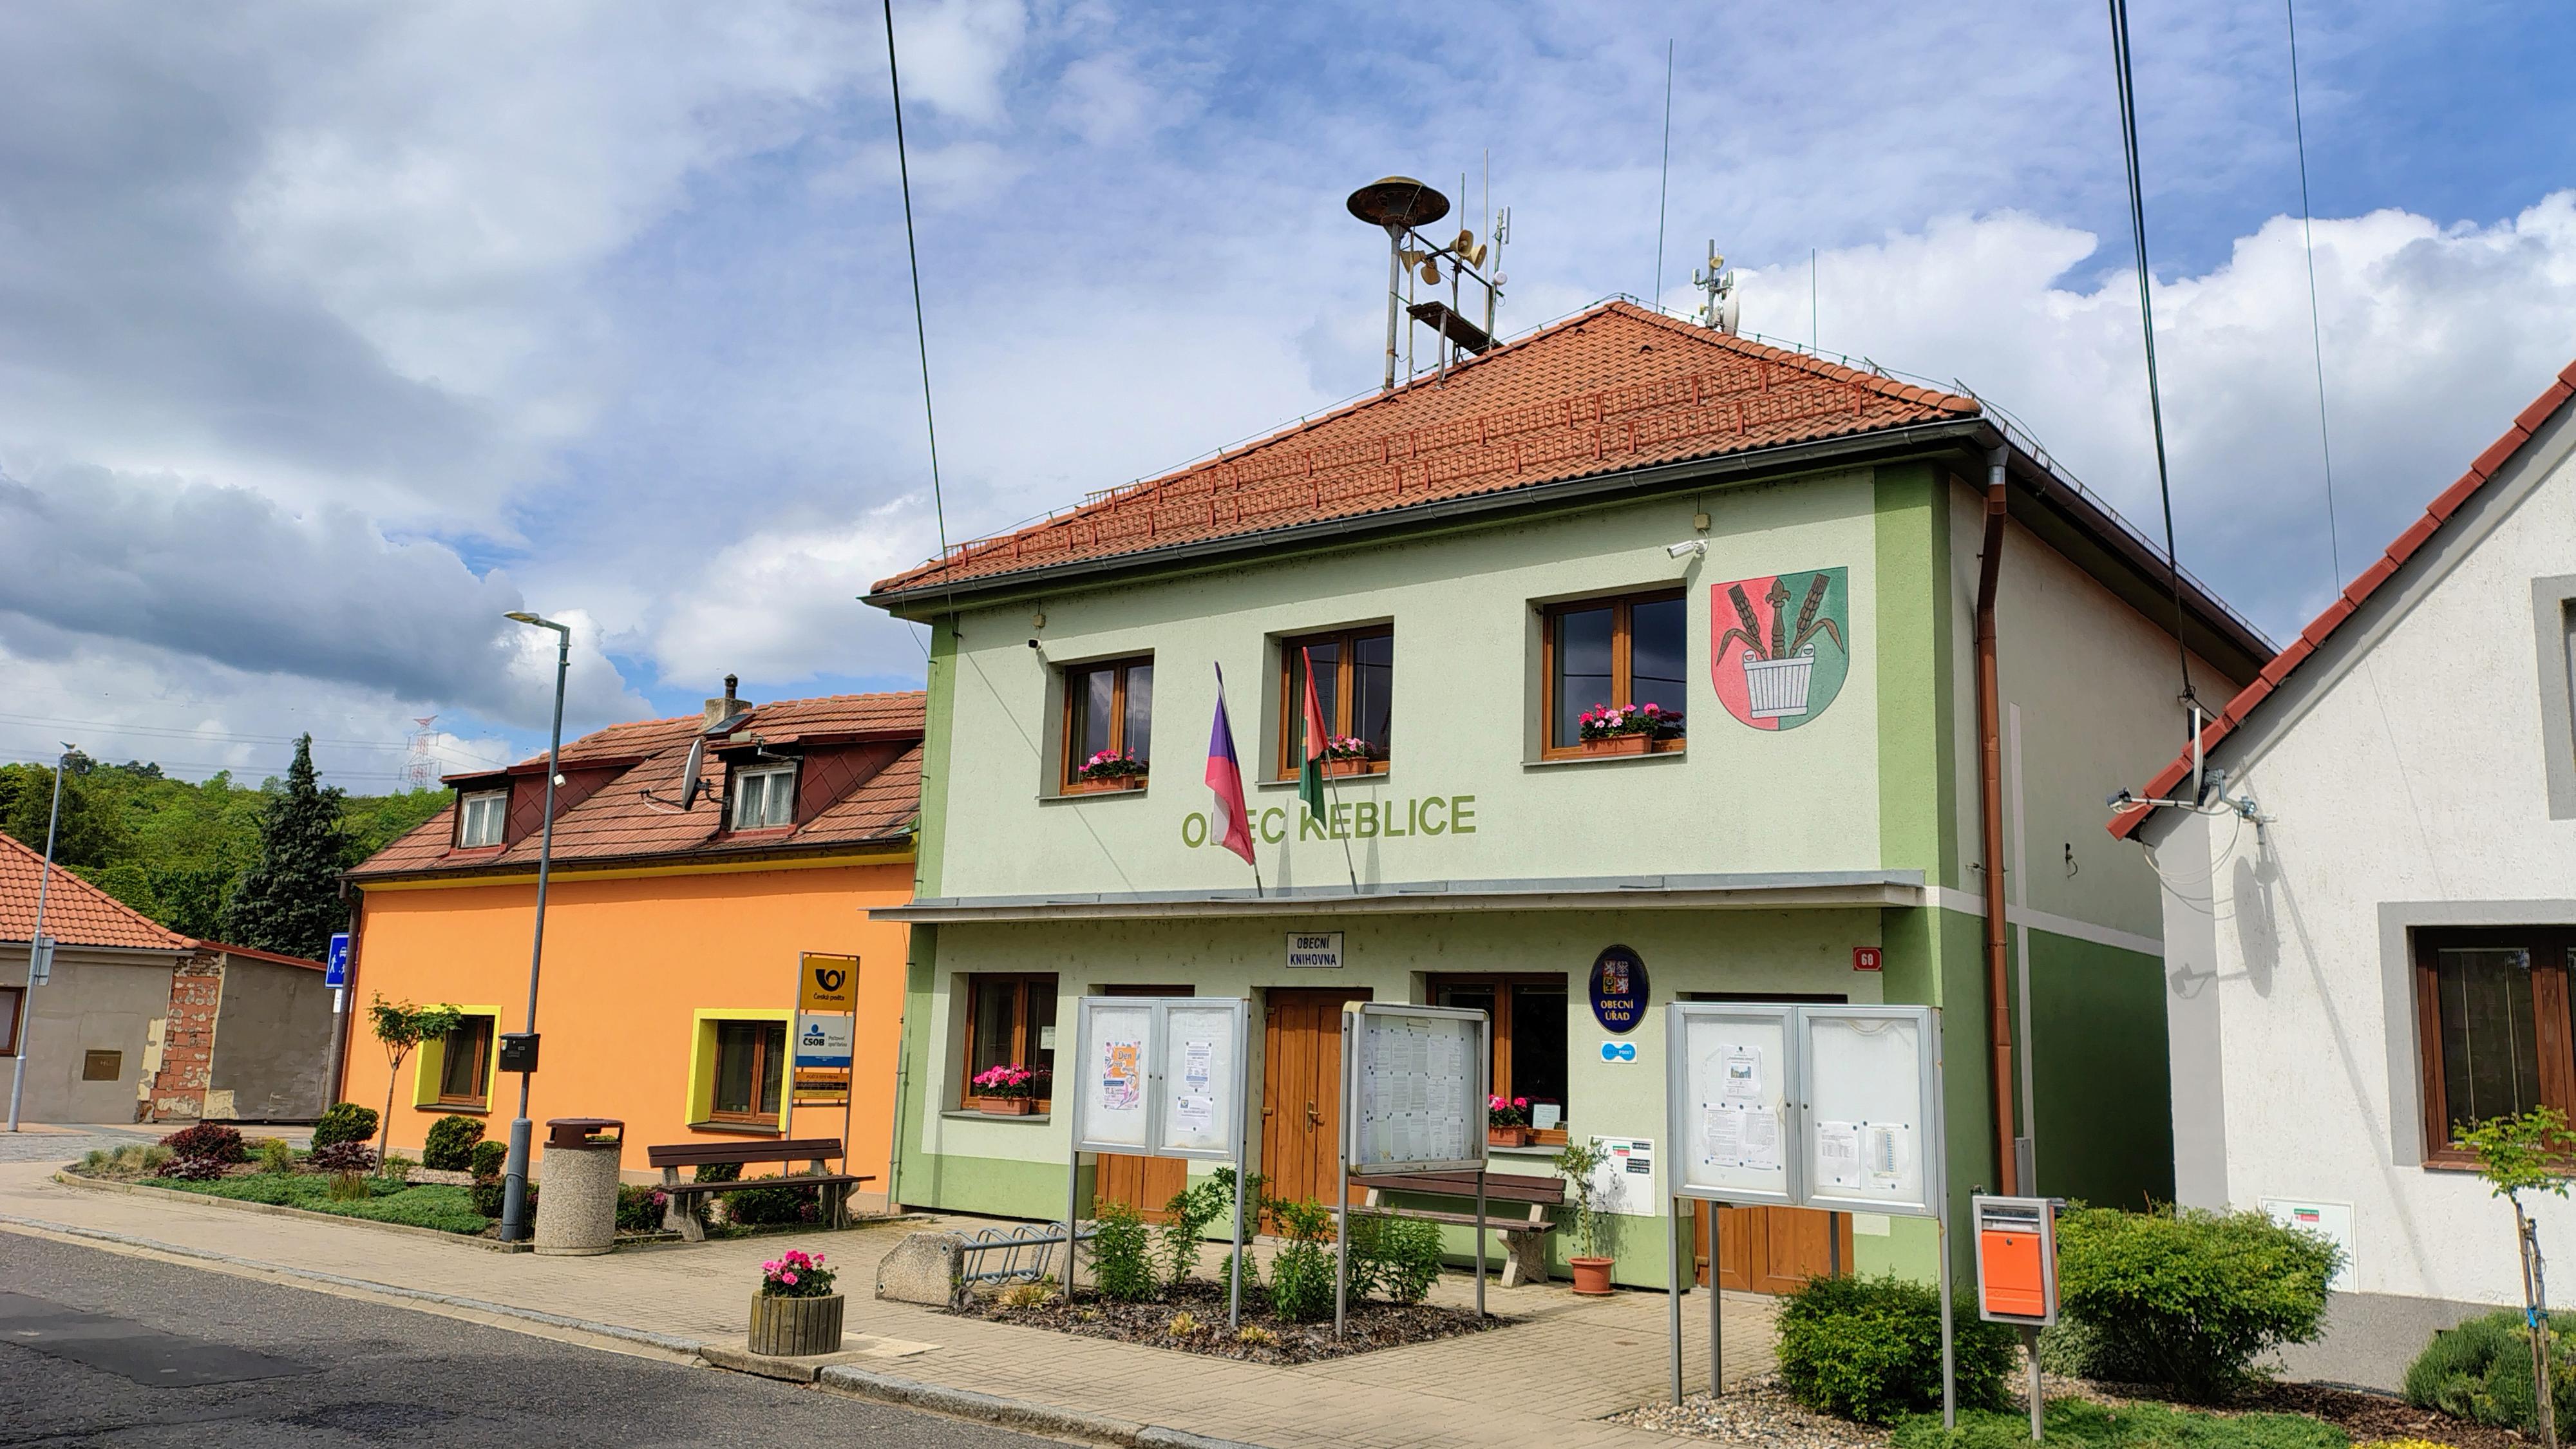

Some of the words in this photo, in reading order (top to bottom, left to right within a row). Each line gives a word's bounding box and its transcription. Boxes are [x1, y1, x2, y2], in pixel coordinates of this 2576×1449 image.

[1182, 807, 1286, 849] OC
[1299, 795, 1477, 842] KEBLICE
[1296, 934, 1331, 949] OBECNÍ
[1290, 953, 1337, 965] KNIHOVNA
[1600, 998, 1634, 1009] OBECNÍ
[1605, 1010, 1630, 1021] ÚŘAD
[803, 1037, 825, 1046] ČSOB
